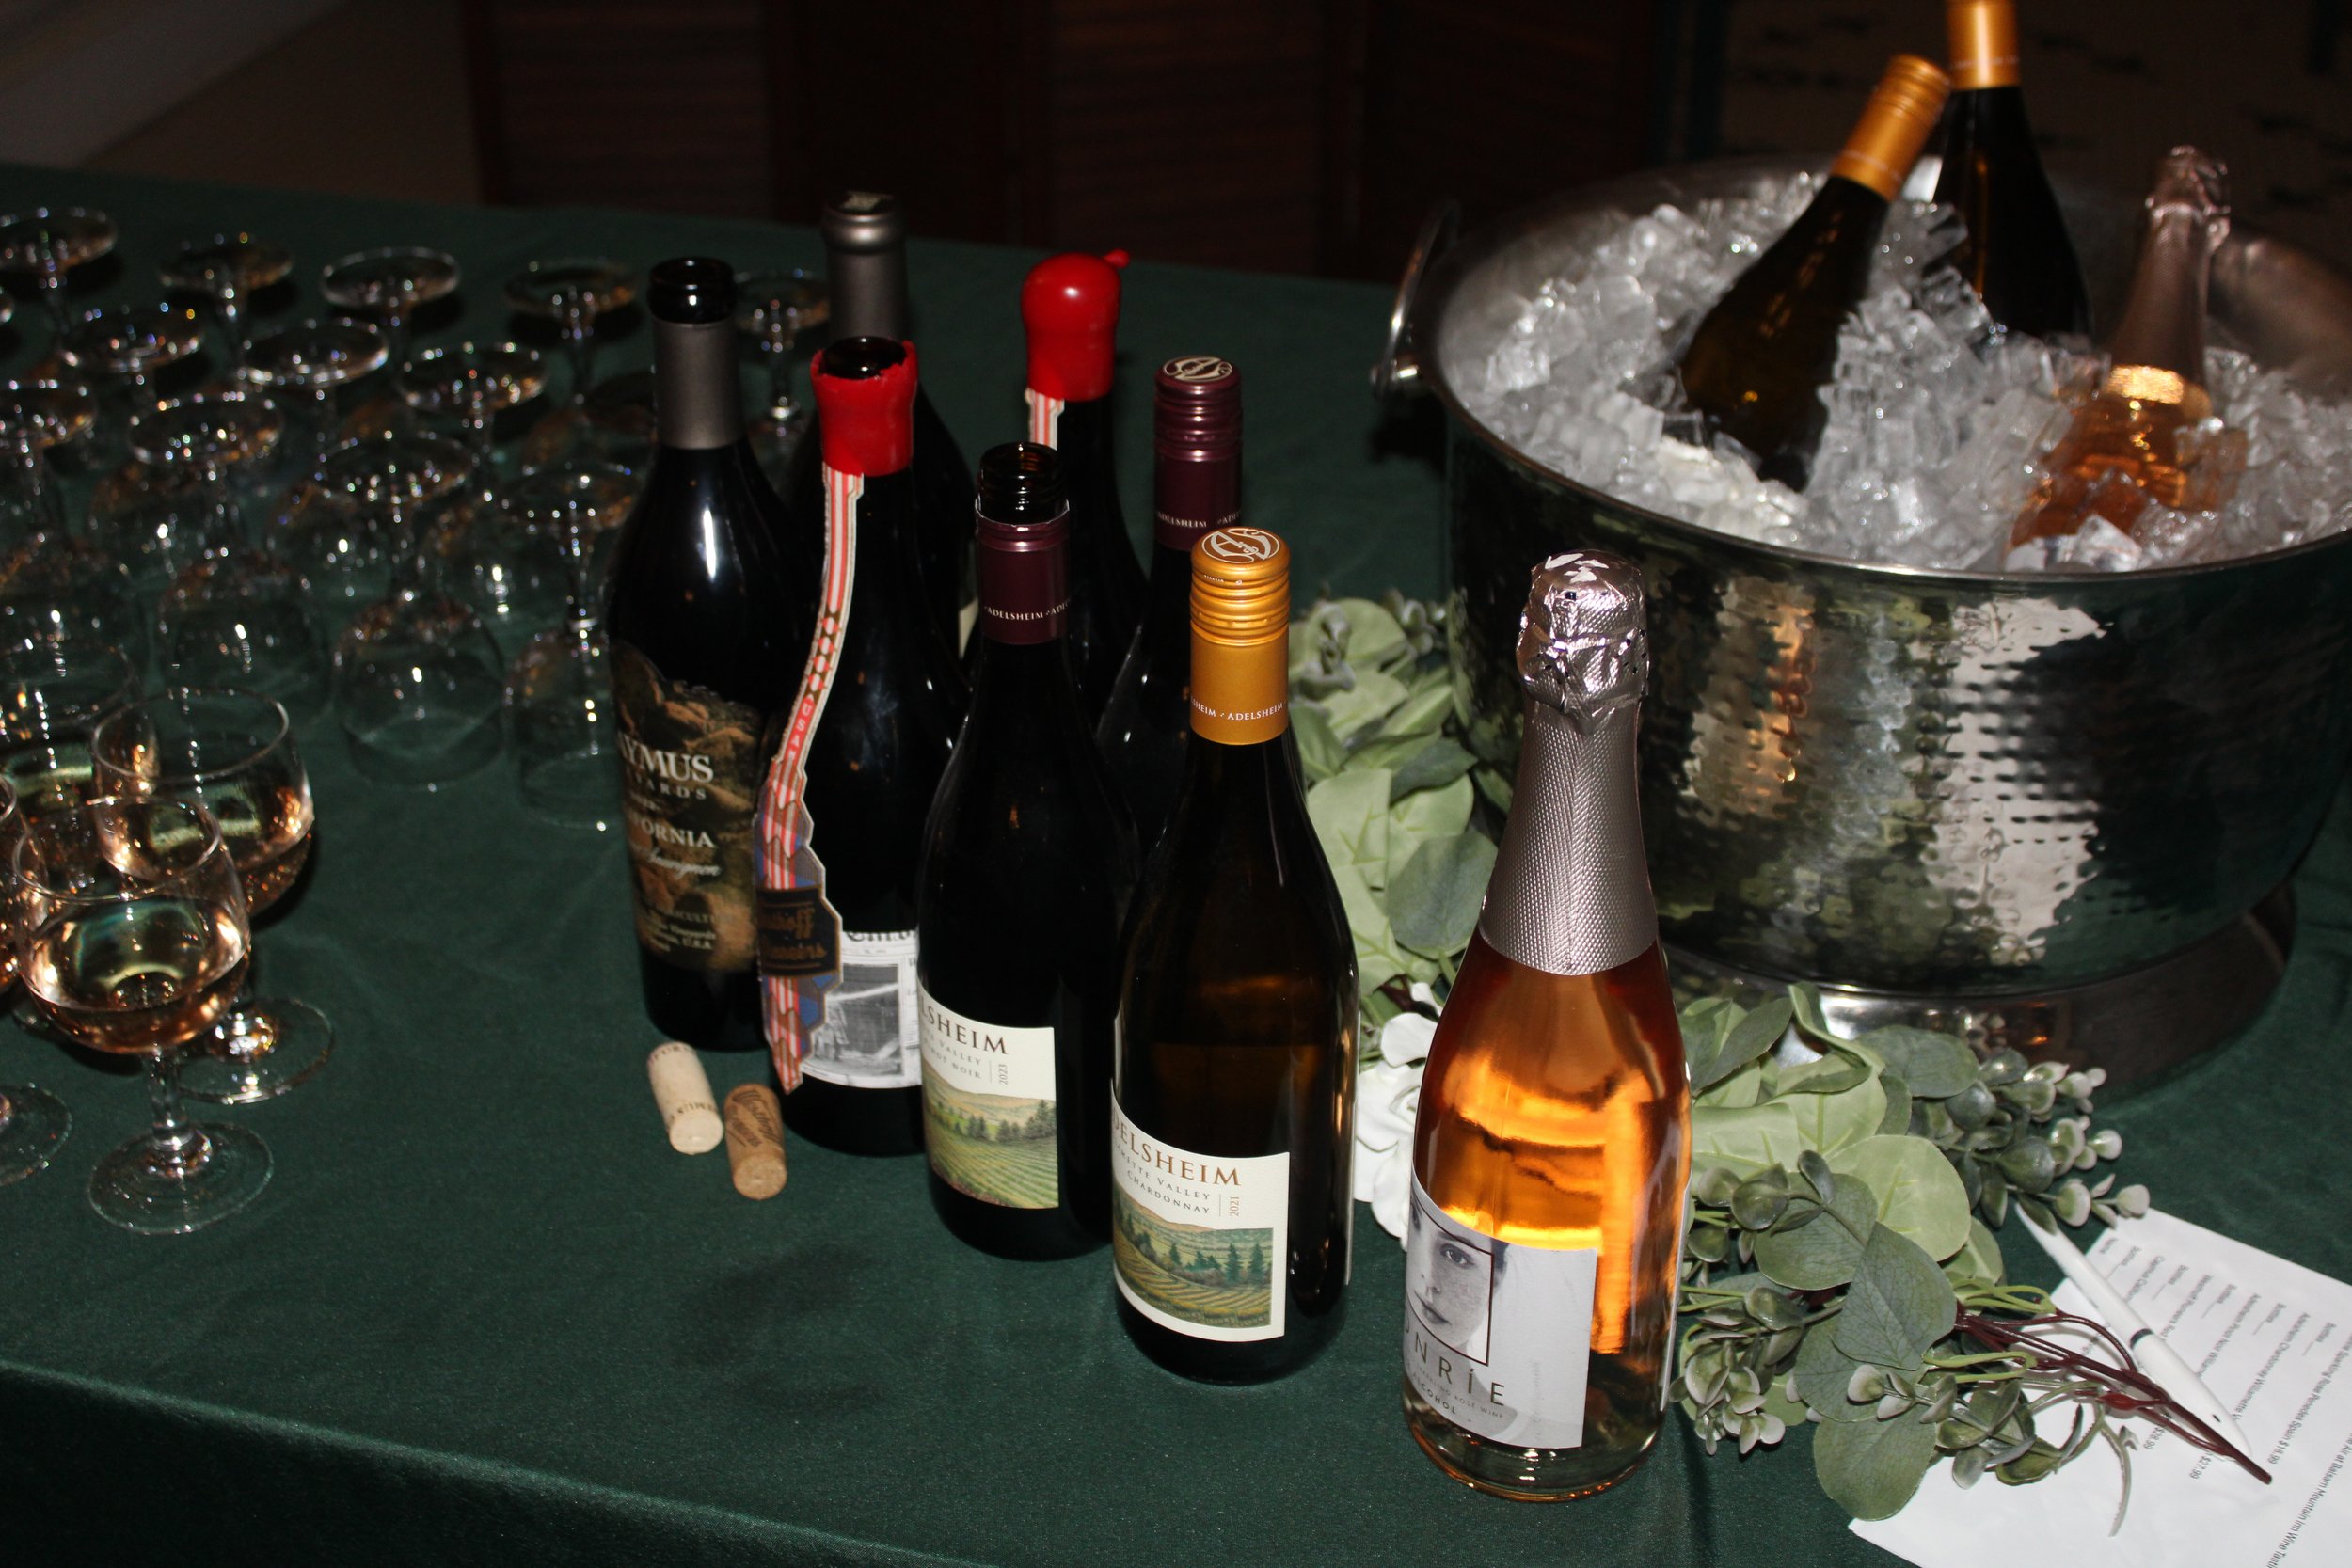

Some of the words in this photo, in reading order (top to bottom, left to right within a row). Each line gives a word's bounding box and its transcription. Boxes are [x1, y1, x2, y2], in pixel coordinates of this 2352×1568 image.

[987, 606, 1043, 621] ADELSHEIM
[1227, 702, 1283, 721] ADELSHEIM
[952, 1062, 982, 1079] NOIR
[1127, 1170, 1211, 1214] CHARDONNAY
[1157, 1177, 1211, 1201] VALLEY
[1229, 1196, 1240, 1217] 2021
[2282, 1421, 2302, 1440] Spain
[2267, 1440, 2289, 1464] $18.99
[2189, 1456, 2211, 1479] $27.99
[2319, 1463, 2343, 1488] Balsam
[2298, 1488, 2326, 1520] Mountain
[2290, 1520, 2305, 1531] Inn
[2279, 1532, 2298, 1550] Wine
